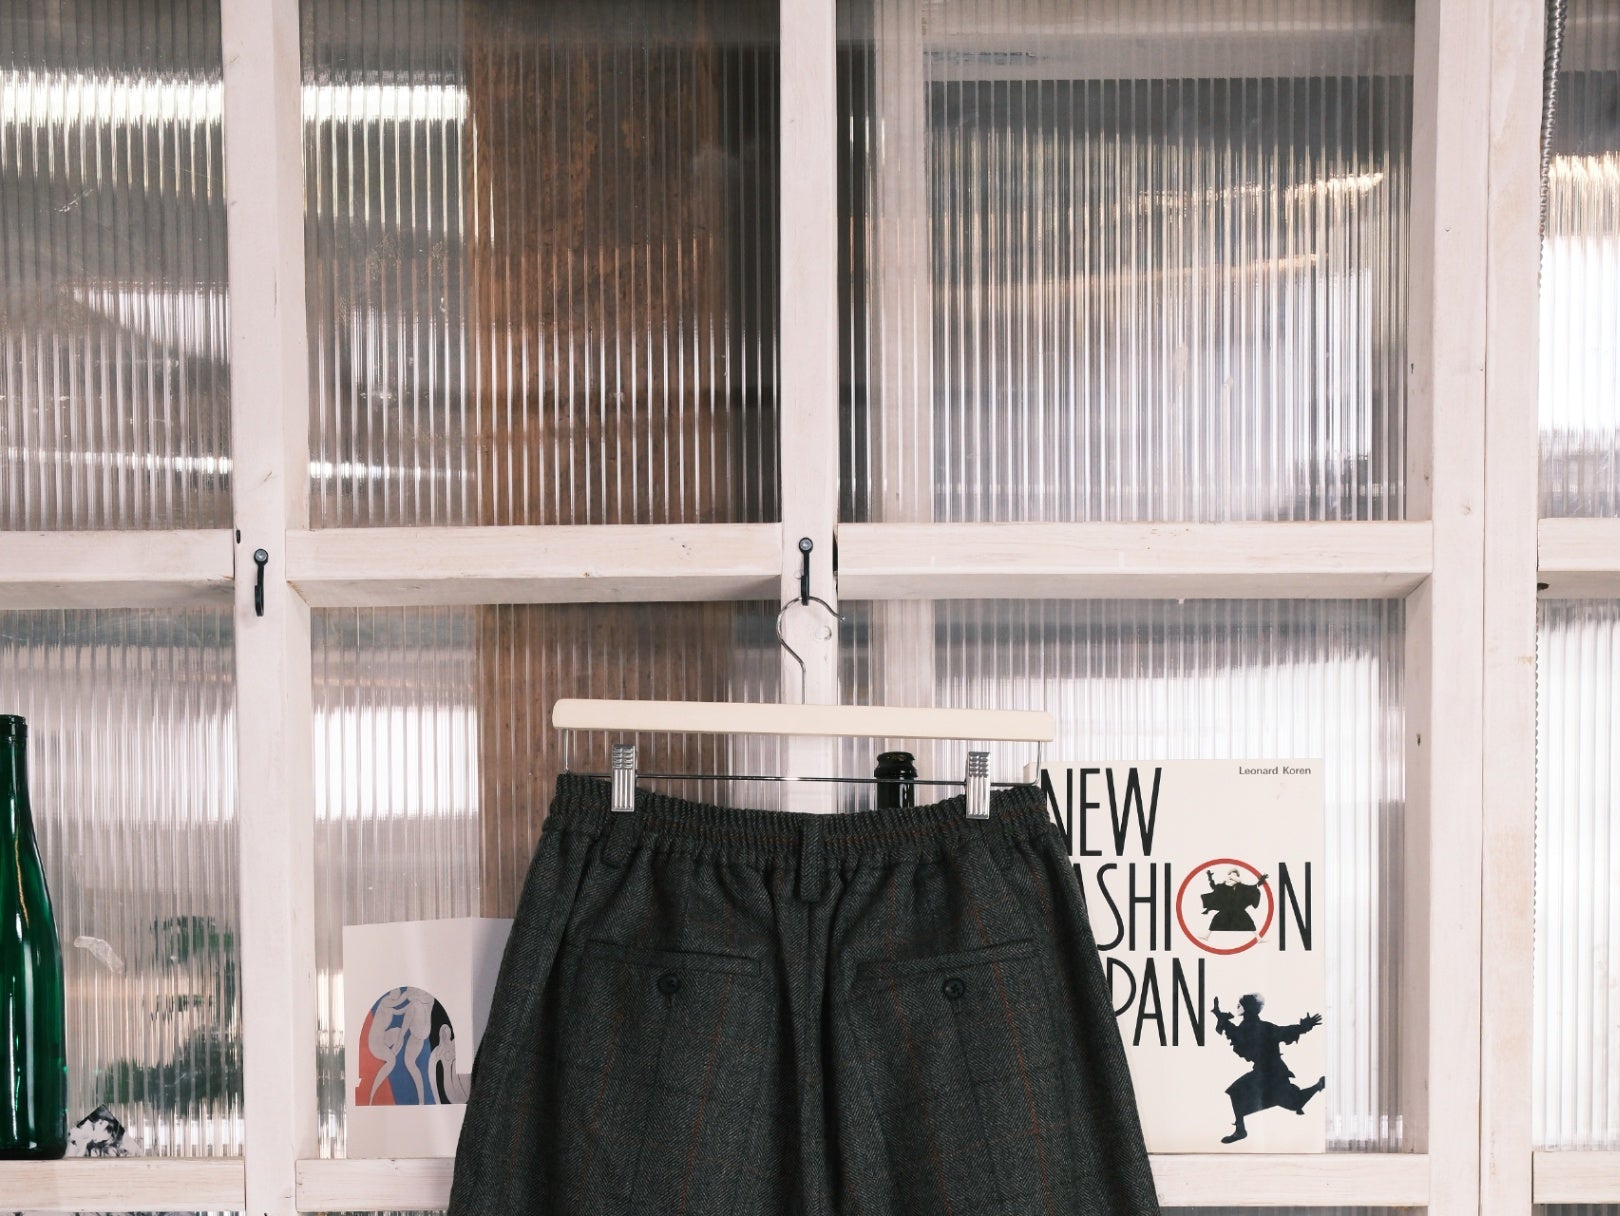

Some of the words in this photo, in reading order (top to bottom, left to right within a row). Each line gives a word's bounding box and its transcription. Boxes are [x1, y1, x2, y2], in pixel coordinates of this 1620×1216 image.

[1041, 767, 1162, 856] NEW
[1239, 766, 1278, 775] Leonard
[1282, 766, 1311, 775] Koren
[1074, 858, 1312, 955] SHION
